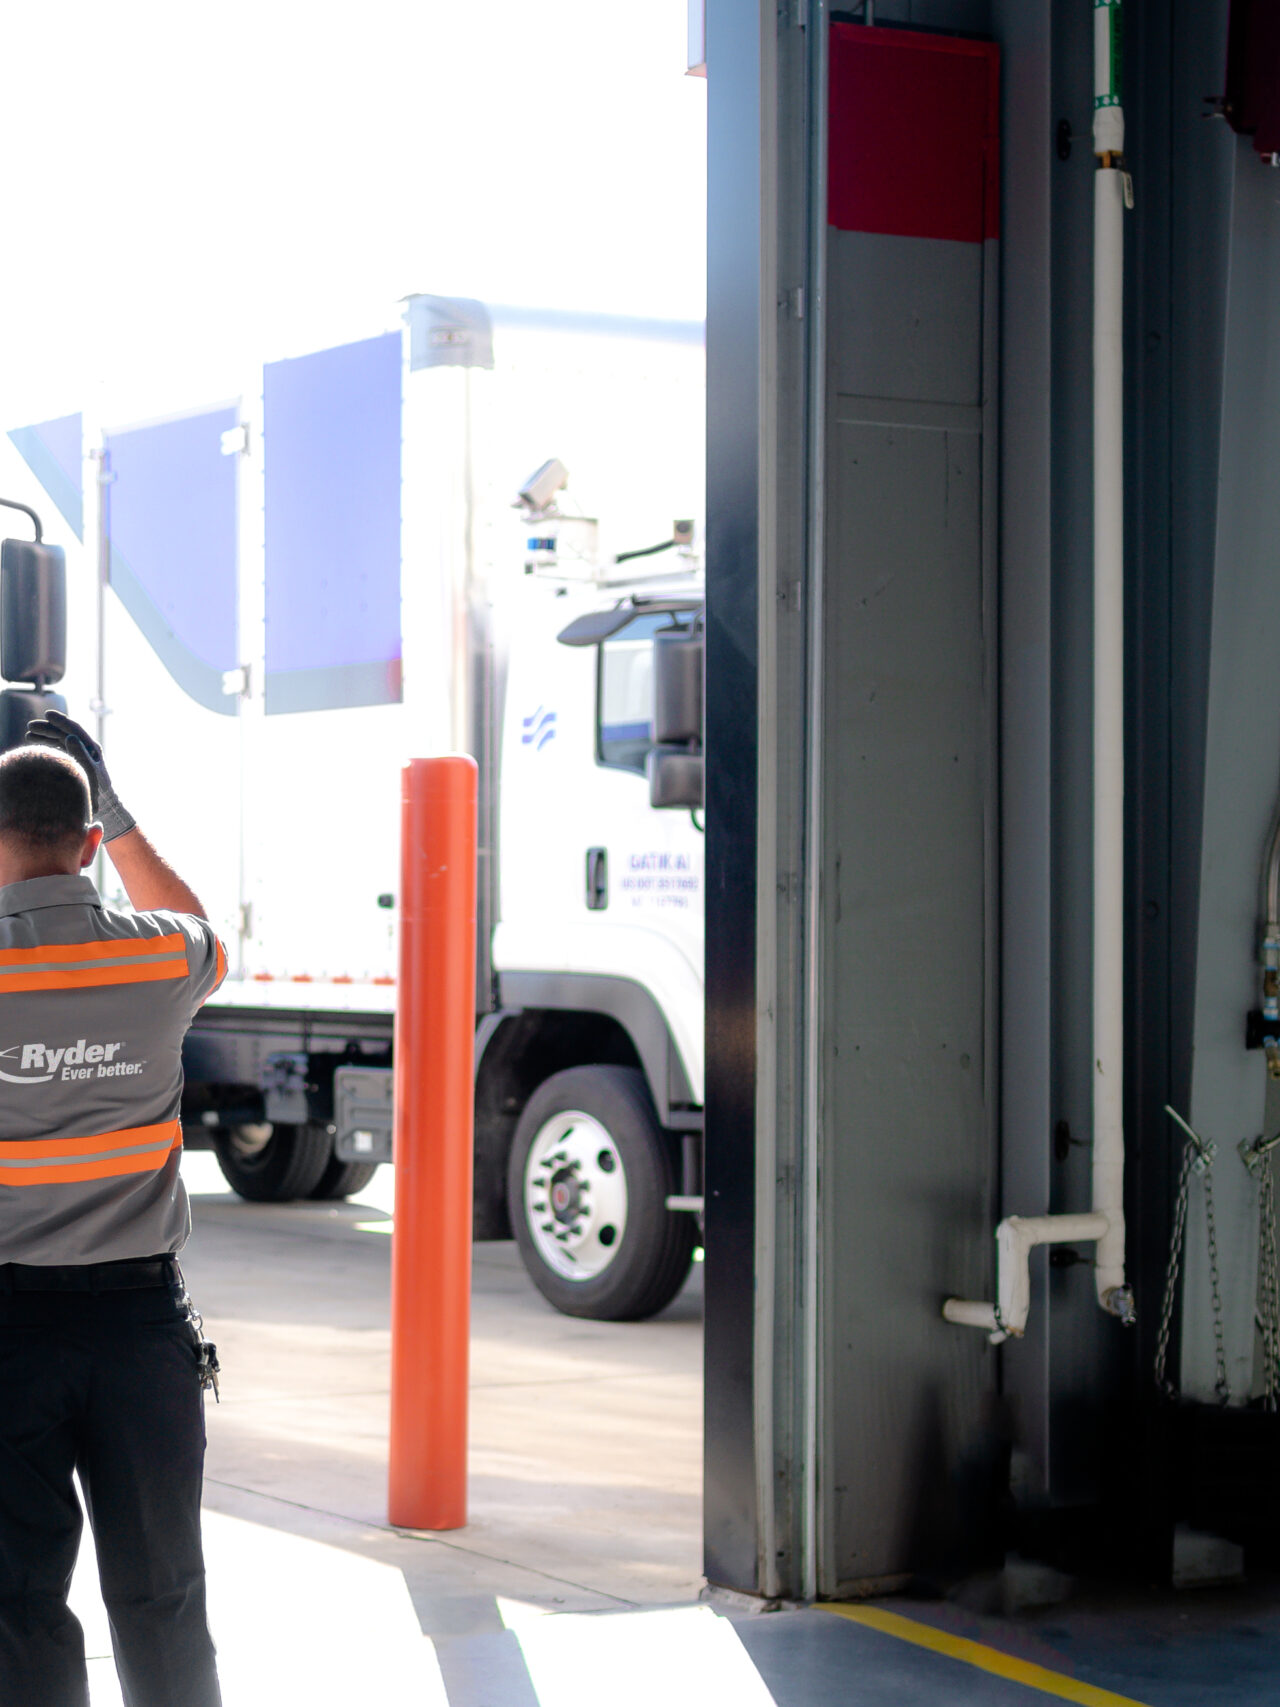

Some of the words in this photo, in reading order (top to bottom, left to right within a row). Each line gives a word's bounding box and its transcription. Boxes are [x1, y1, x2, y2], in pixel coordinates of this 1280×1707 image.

[20, 1039, 121, 1074] Ryder
[61, 1067, 93, 1081] Ever
[97, 1062, 144, 1078] better.
